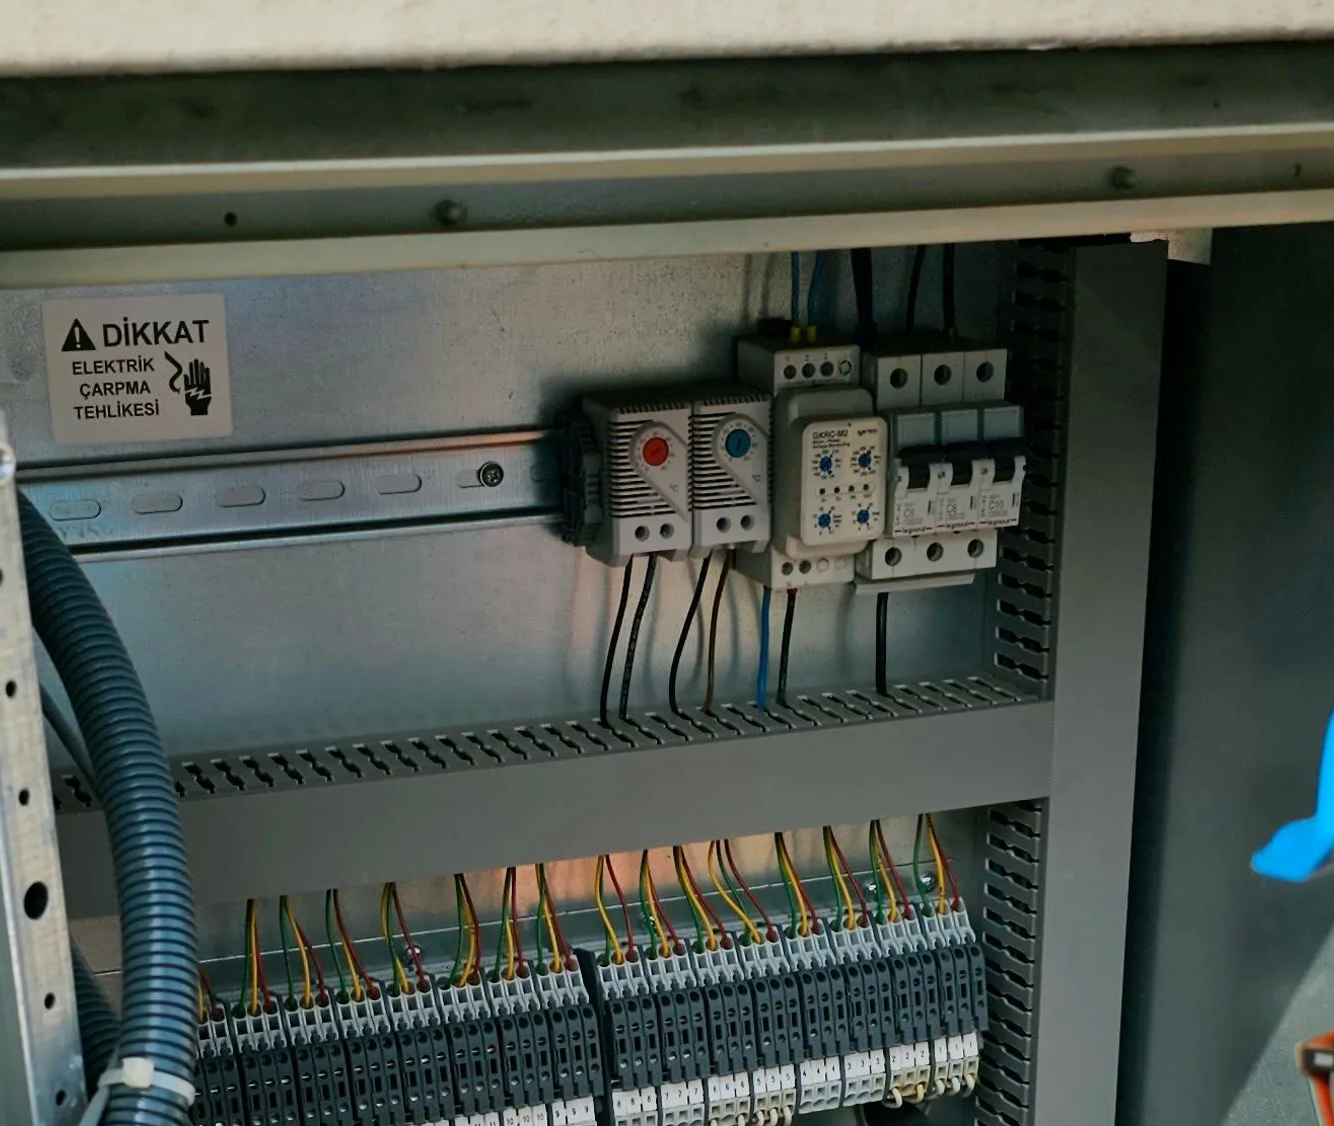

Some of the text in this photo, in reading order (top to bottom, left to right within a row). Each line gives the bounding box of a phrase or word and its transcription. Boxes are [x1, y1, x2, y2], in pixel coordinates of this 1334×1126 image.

[103, 317, 209, 347] DİKKAT
[72, 355, 155, 375] ELEKTRİK
[79, 381, 151, 400] ÇARPMA
[74, 399, 160, 420] TEHLİKESİ
